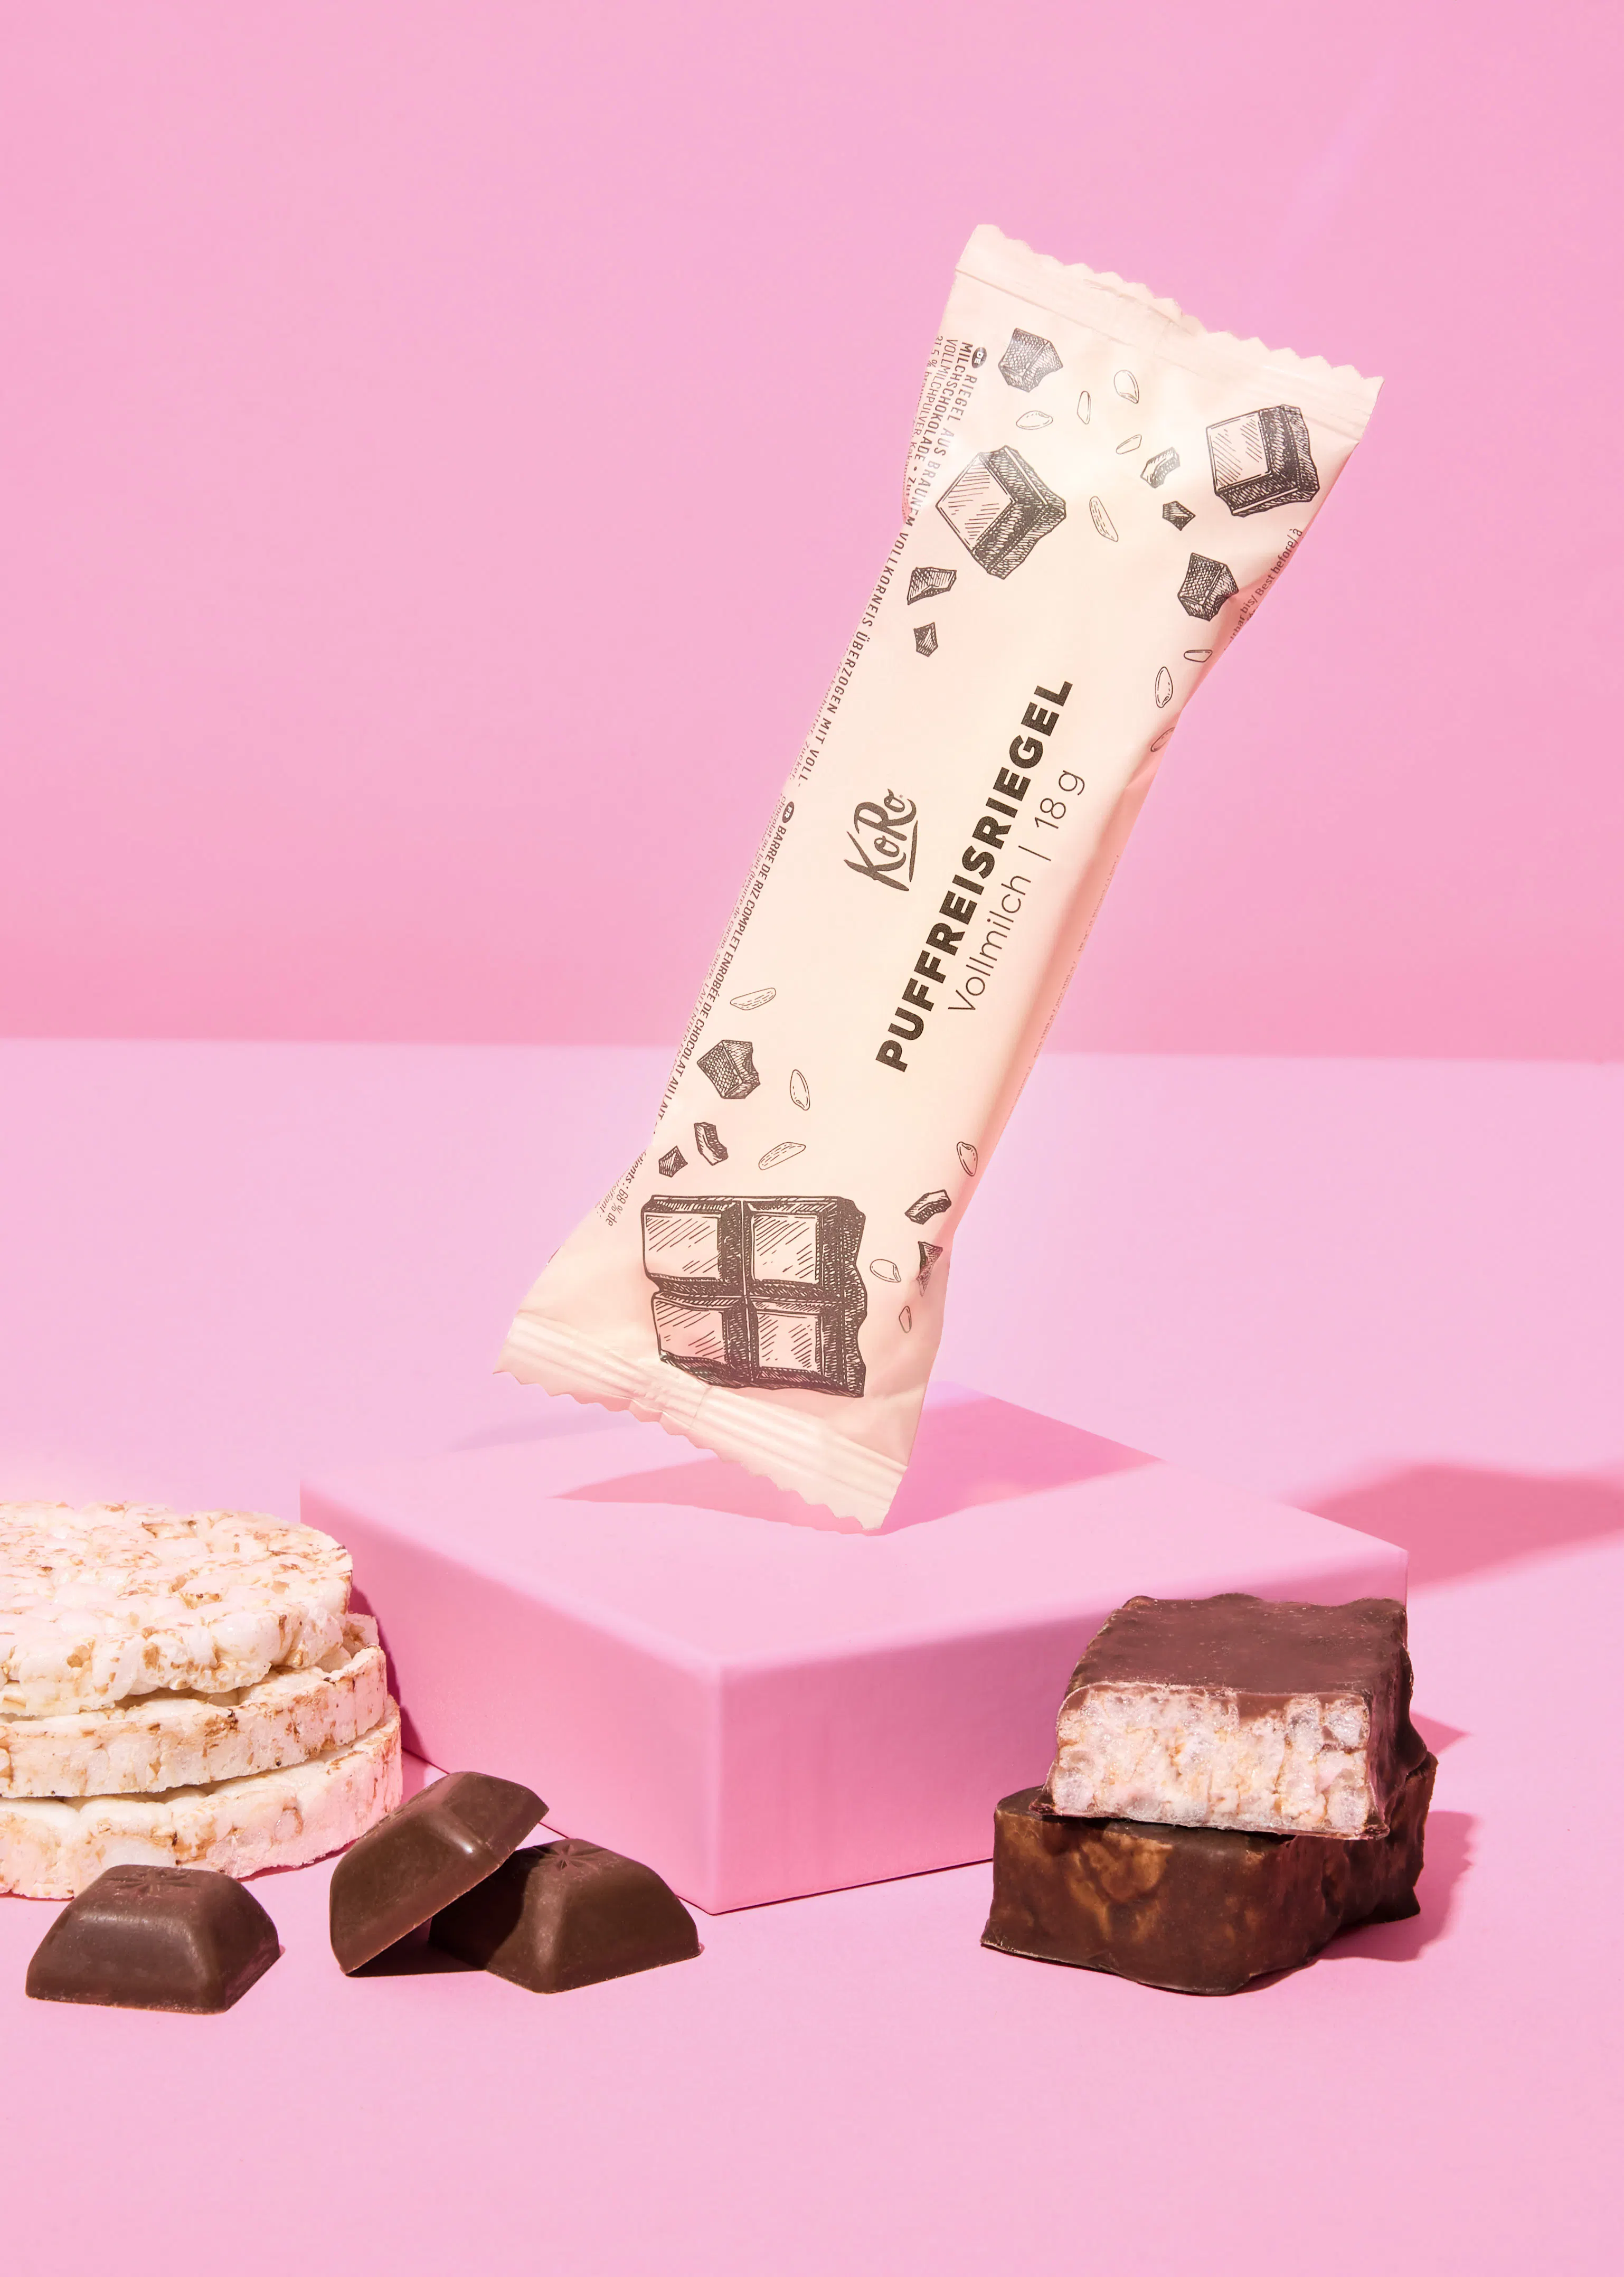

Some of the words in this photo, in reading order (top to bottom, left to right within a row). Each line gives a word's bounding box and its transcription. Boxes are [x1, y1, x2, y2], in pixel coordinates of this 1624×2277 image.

[914, 342, 973, 462] MILCHSCHOKOLADE
[947, 374, 977, 421] RIEGEL
[934, 428, 954, 456] AUS
[862, 532, 909, 627] VOLLKORNEIS
[1254, 574, 1276, 597] Best
[827, 631, 870, 714] ÜBERZOGEN
[815, 717, 832, 745] MIT
[798, 749, 819, 787] VOLL-
[765, 825, 787, 864] BARRE
[844, 788, 917, 891] KoRo
[750, 880, 763, 900] RIZ
[758, 863, 771, 880] DE
[876, 682, 1072, 1072] PUFFREISRIEGEL
[948, 876, 1031, 1010] Vollmilch
[1034, 797, 1066, 829] 18
[1059, 770, 1085, 796] g
[729, 899, 755, 952] COMPLET
[707, 951, 733, 1002] ENROBÉE
[700, 1002, 712, 1019] DE
[675, 1019, 704, 1077] CHOCOLAT
[667, 1076, 678, 1094] AU
[658, 1094, 672, 1121] LAIT
[616, 1189, 628, 1204] 68
[606, 1212, 617, 1226] de
